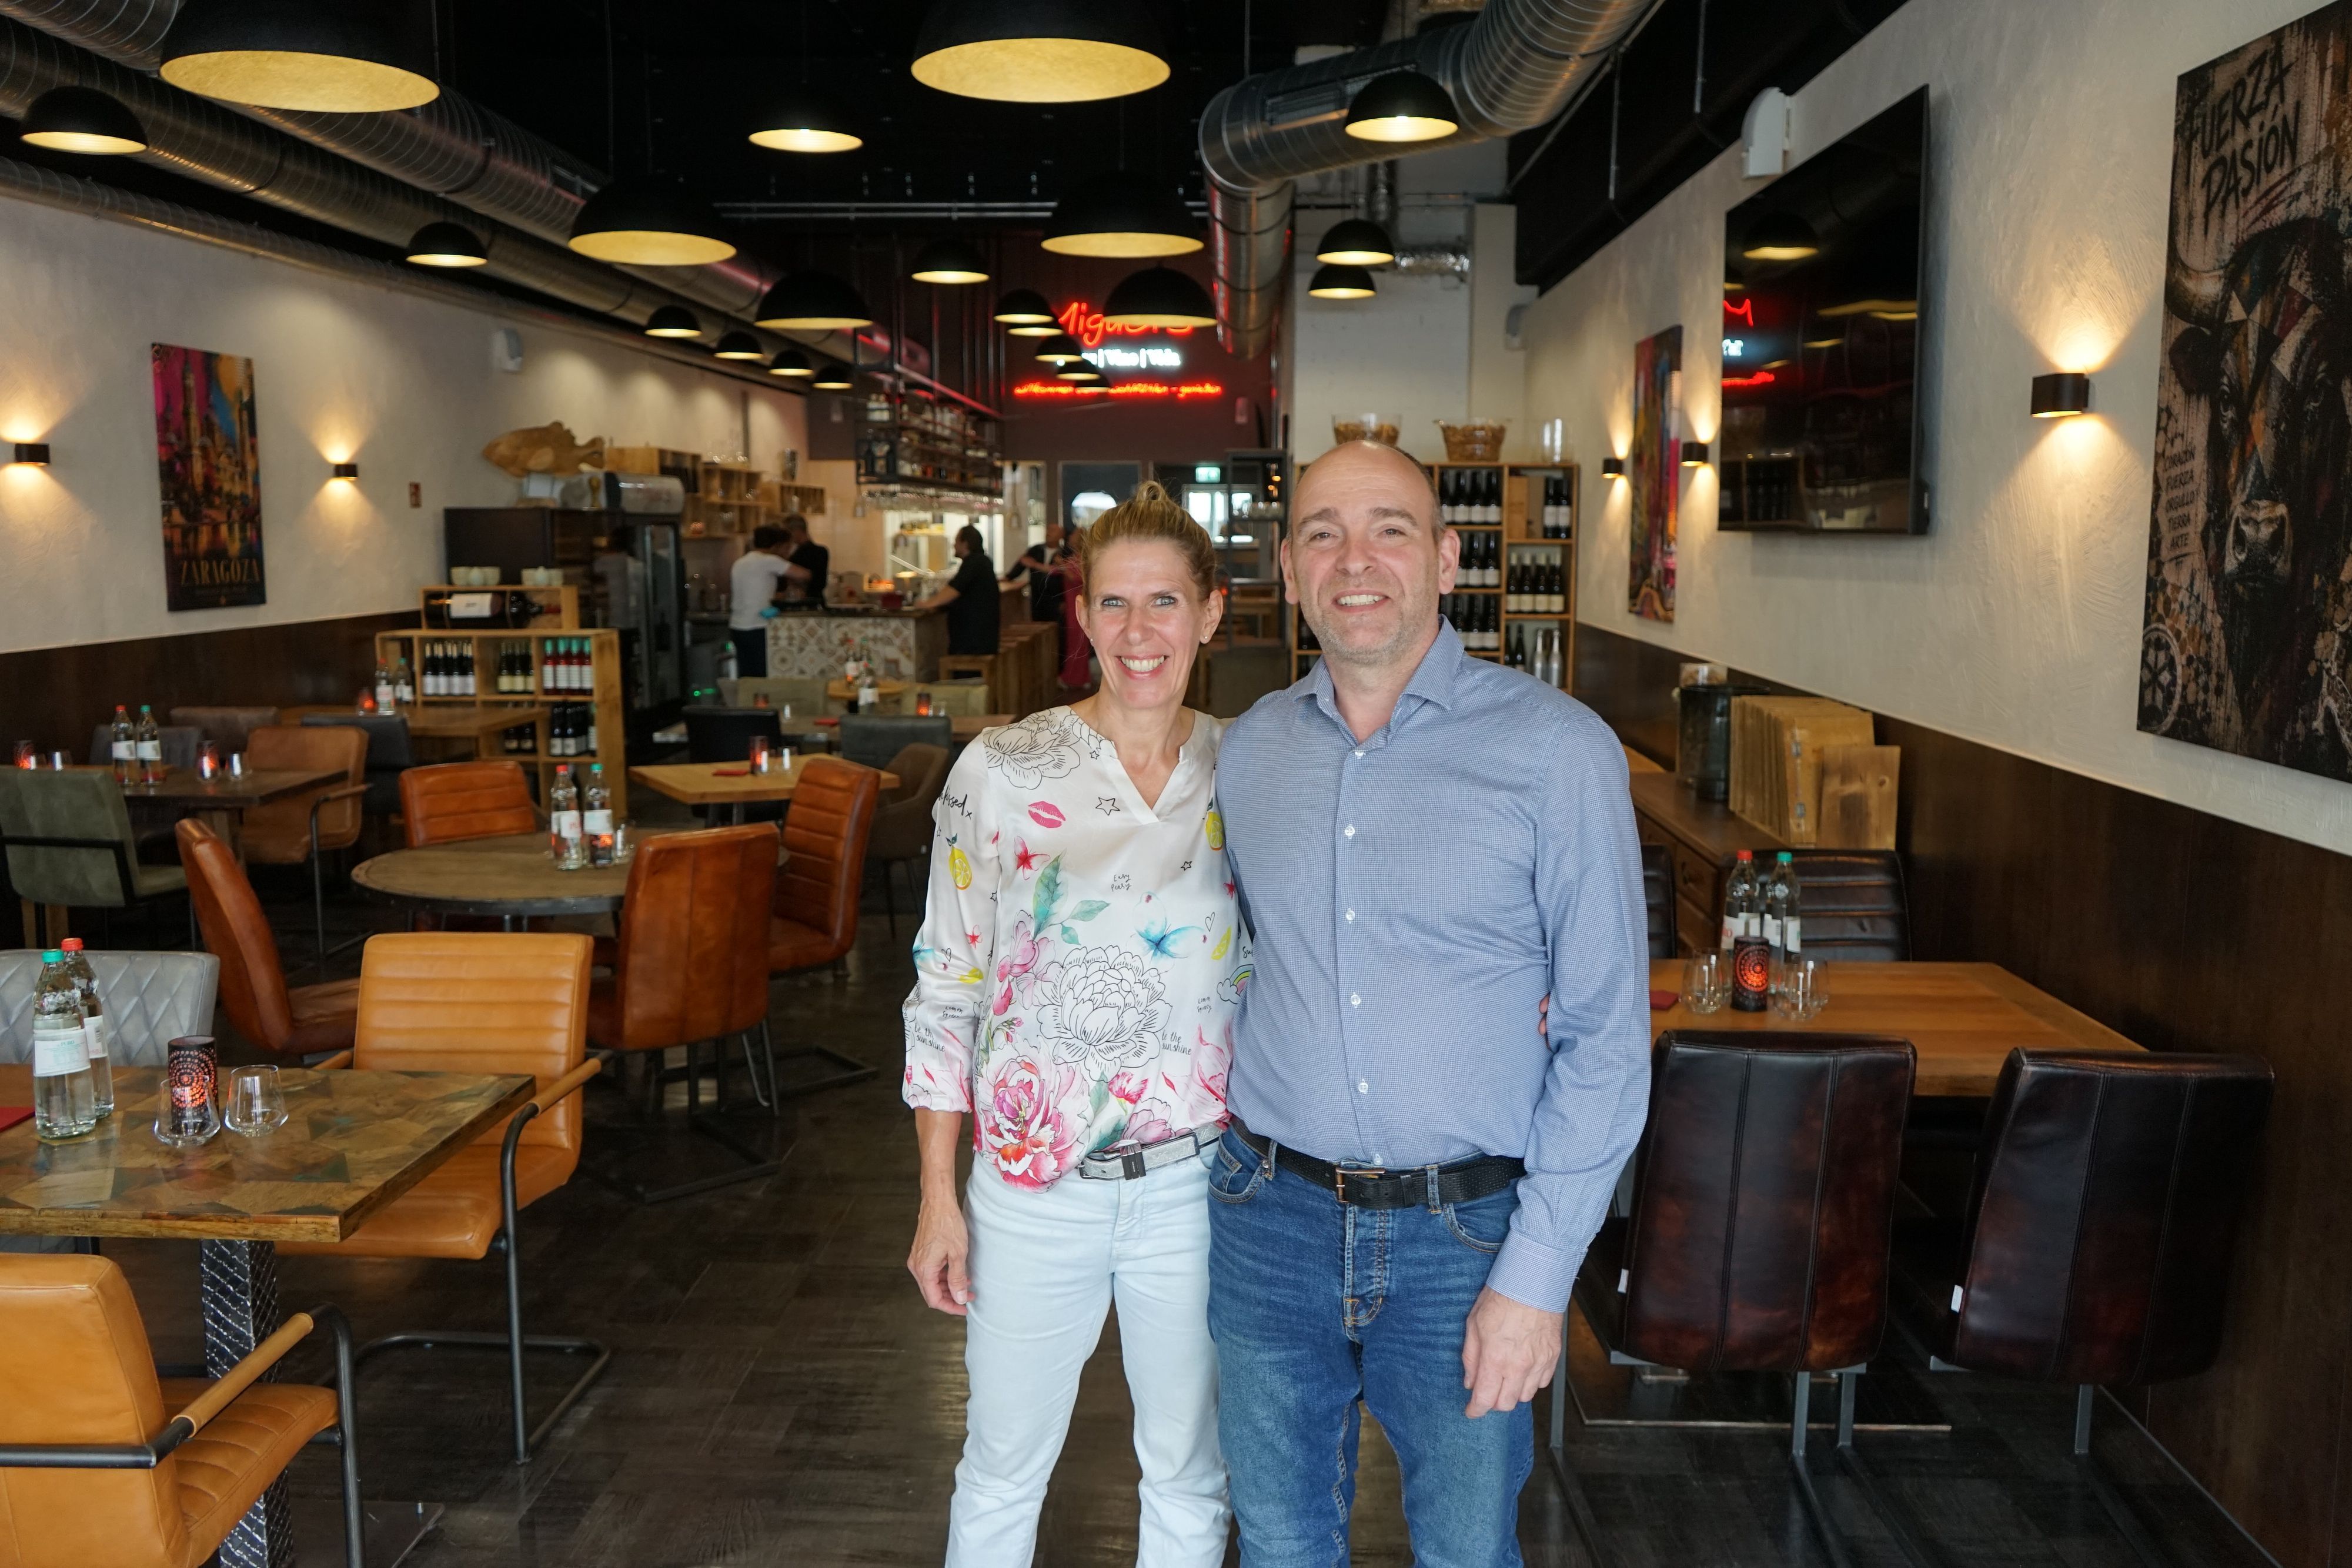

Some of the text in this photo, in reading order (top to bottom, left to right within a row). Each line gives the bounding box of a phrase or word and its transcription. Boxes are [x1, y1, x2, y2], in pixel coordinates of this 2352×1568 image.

[2183, 36, 2298, 187] FUERZA
[2201, 99, 2300, 228] PASIÓN
[181, 559, 260, 586] ZARAGOZA
[2170, 532, 2190, 550] ARTE
